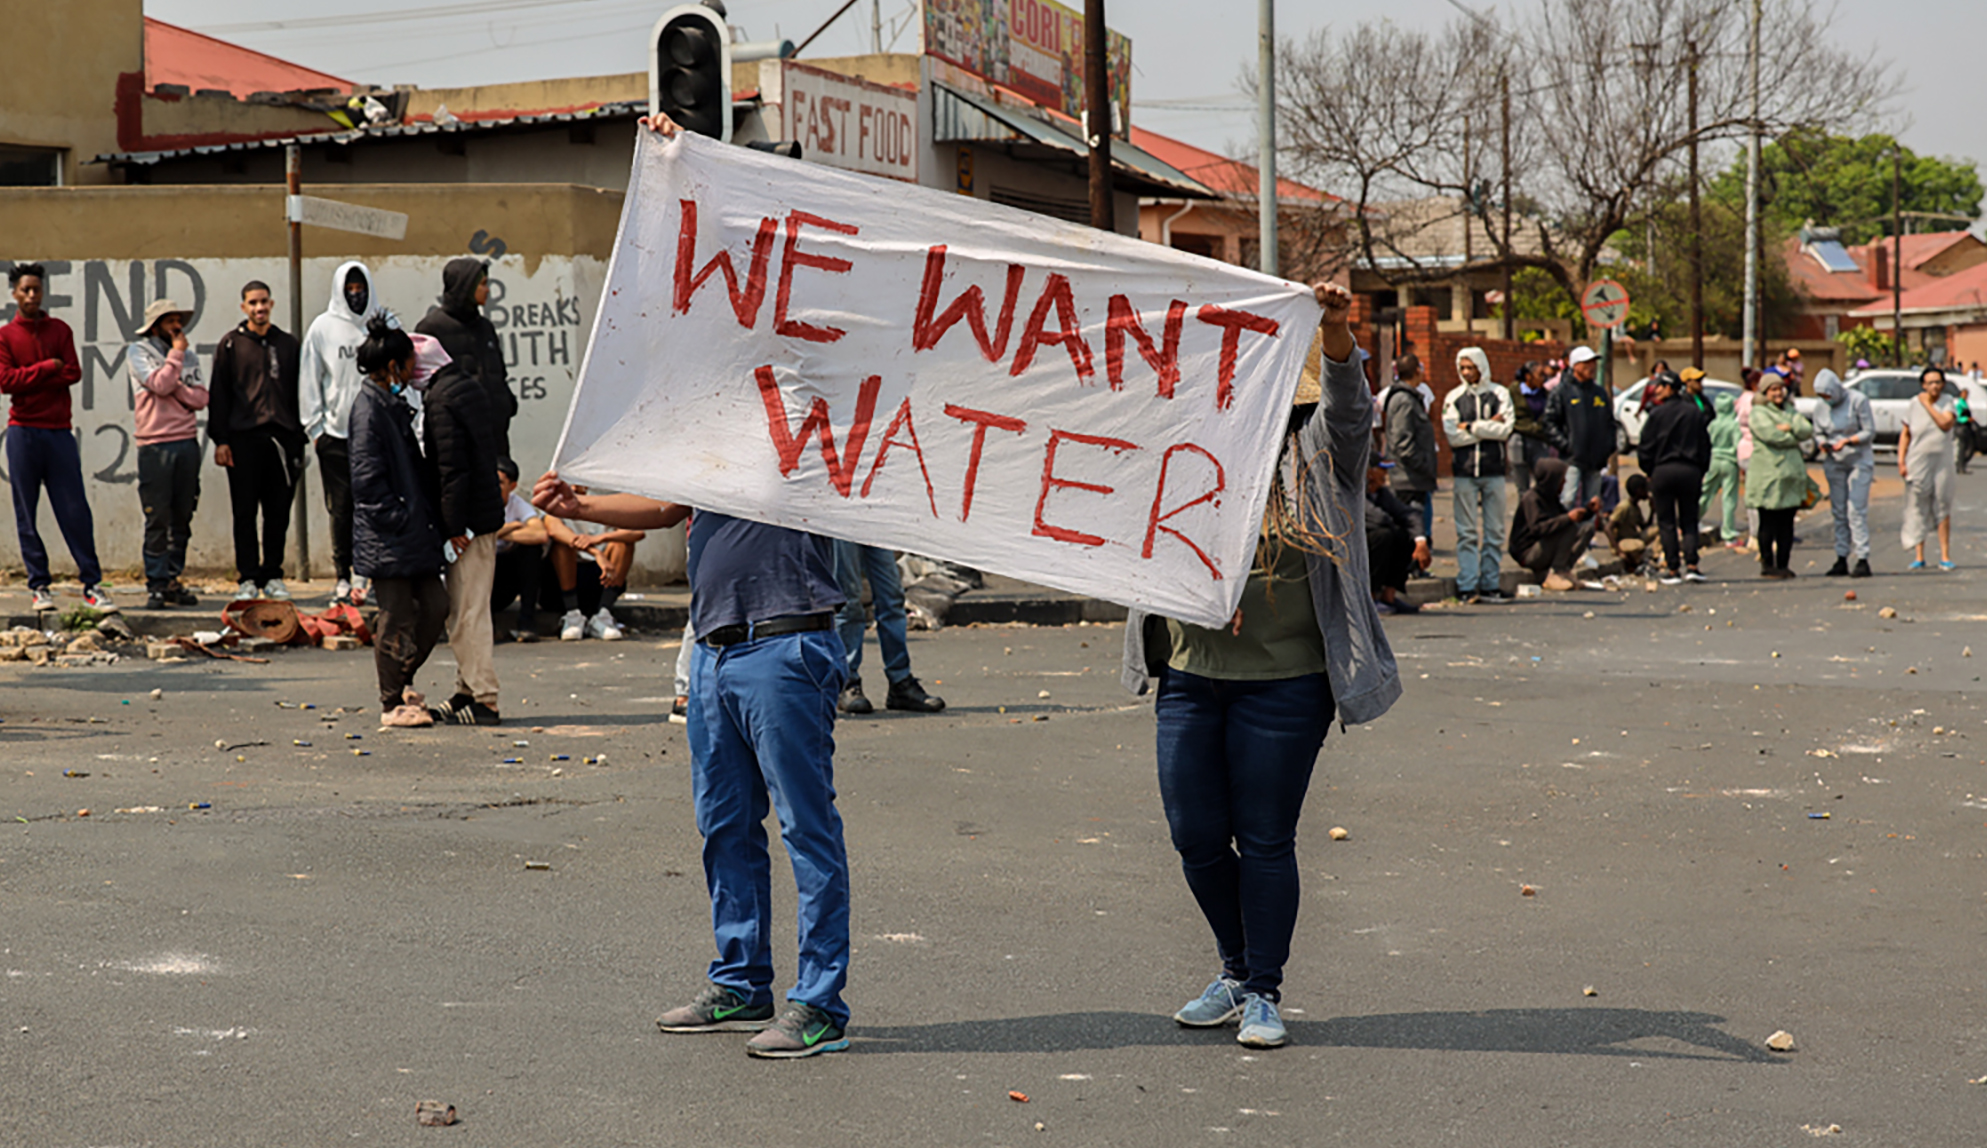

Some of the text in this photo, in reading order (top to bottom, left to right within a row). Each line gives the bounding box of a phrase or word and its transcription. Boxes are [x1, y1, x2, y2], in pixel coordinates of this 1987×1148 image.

[1011, 0, 1060, 54] CORI
[792, 90, 911, 167] FAST FOOD
[673, 199, 1279, 411] WE WANT
[754, 364, 1225, 580] WATER
